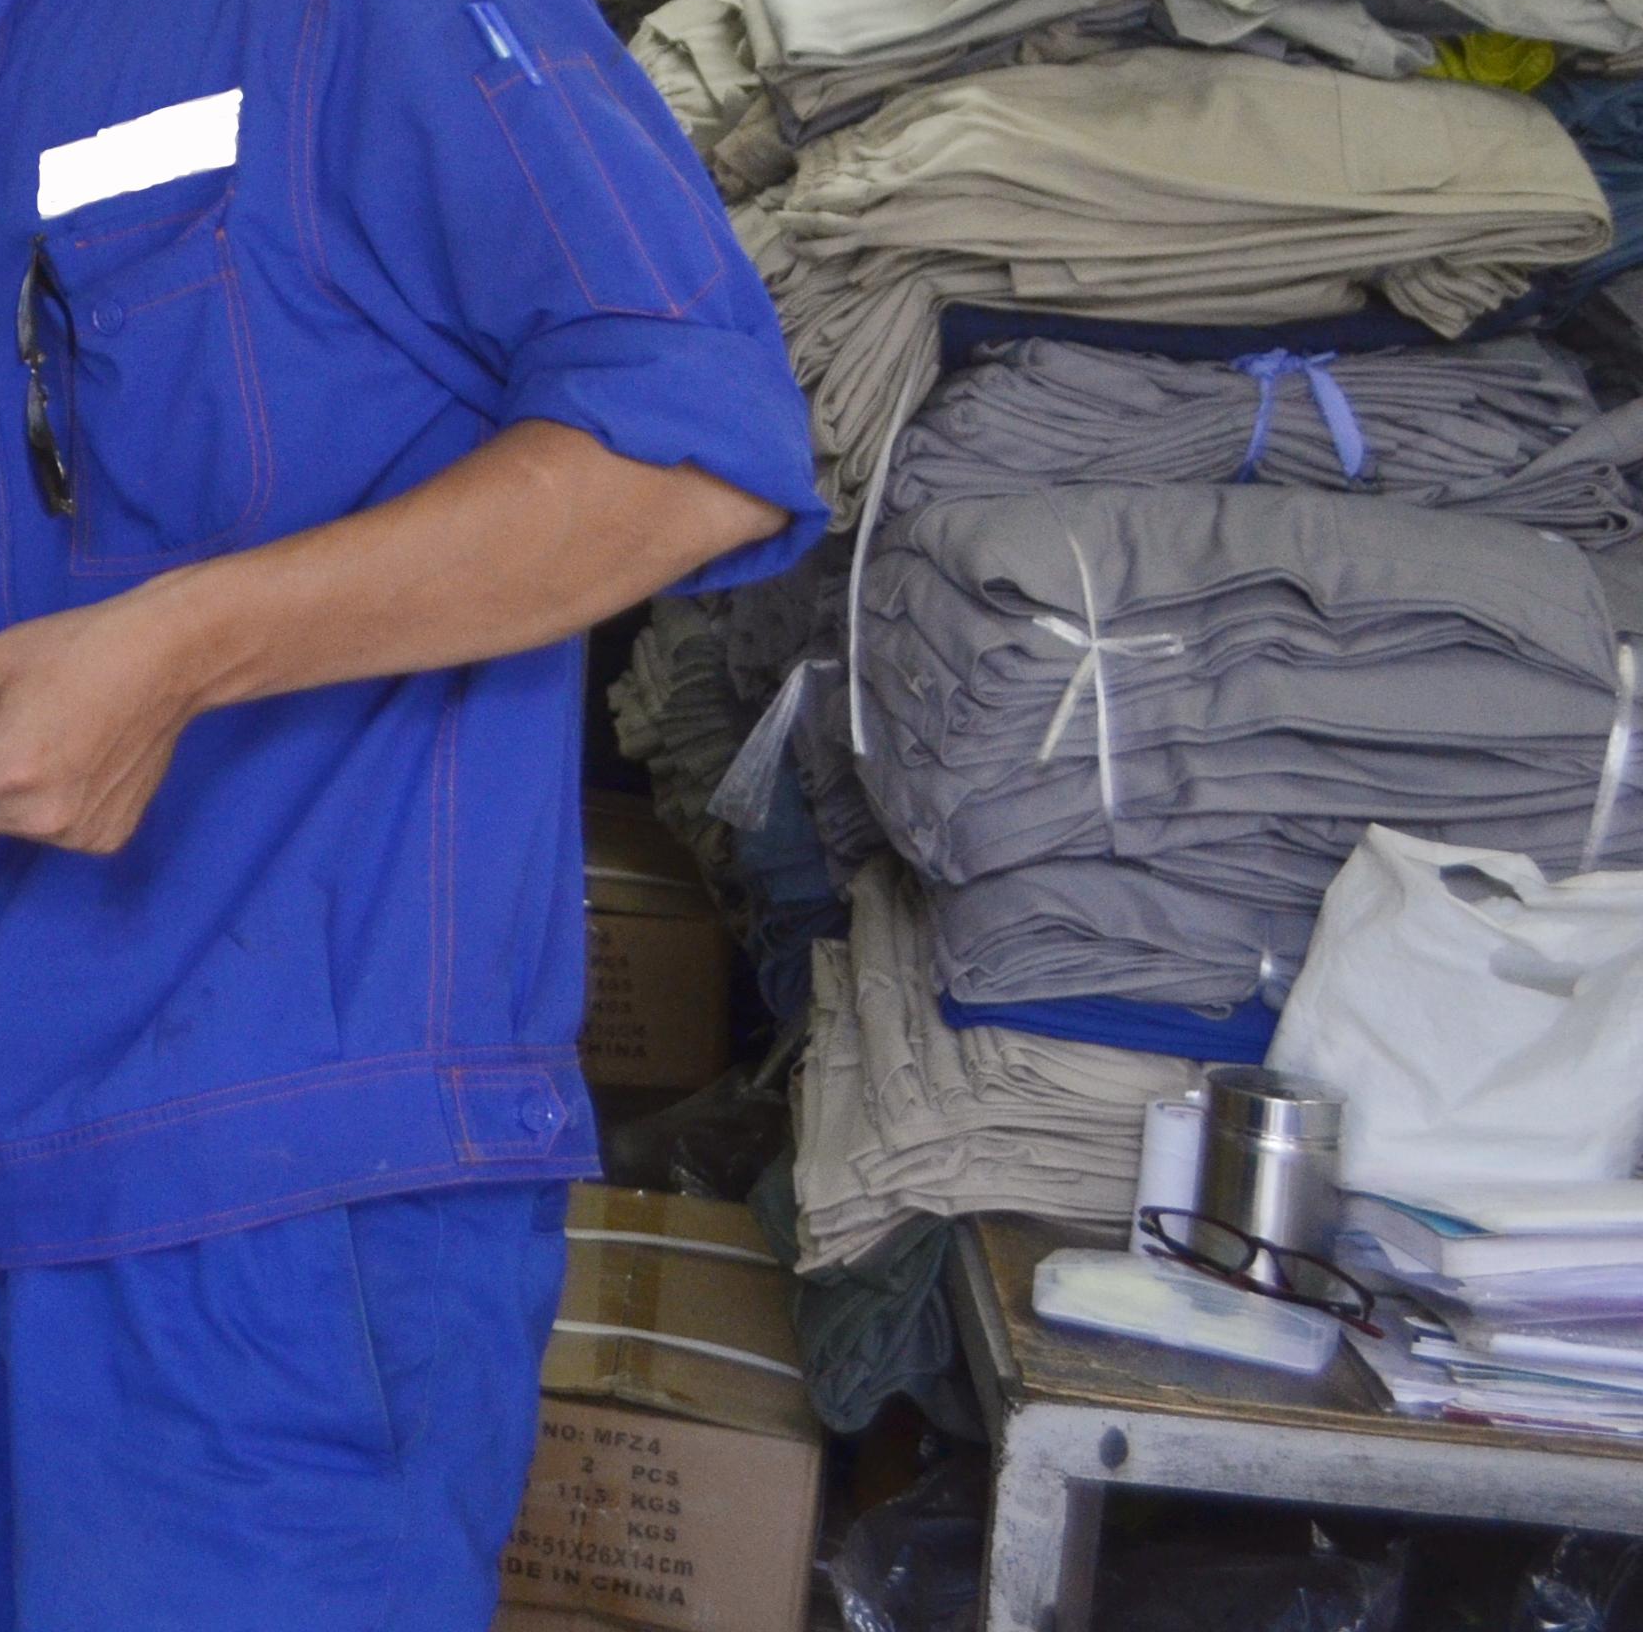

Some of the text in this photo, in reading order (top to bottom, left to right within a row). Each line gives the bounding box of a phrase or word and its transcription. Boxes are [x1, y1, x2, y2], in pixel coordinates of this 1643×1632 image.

[593, 1426, 662, 1456] MFZ4
[580, 1456, 680, 1487] 2 PCS
[631, 1492, 682, 1515] KGS
[626, 1521, 678, 1543] KGS
[510, 1528, 694, 1577] S:51X26X14cm
[505, 1556, 687, 1607] DE IN CHINA
